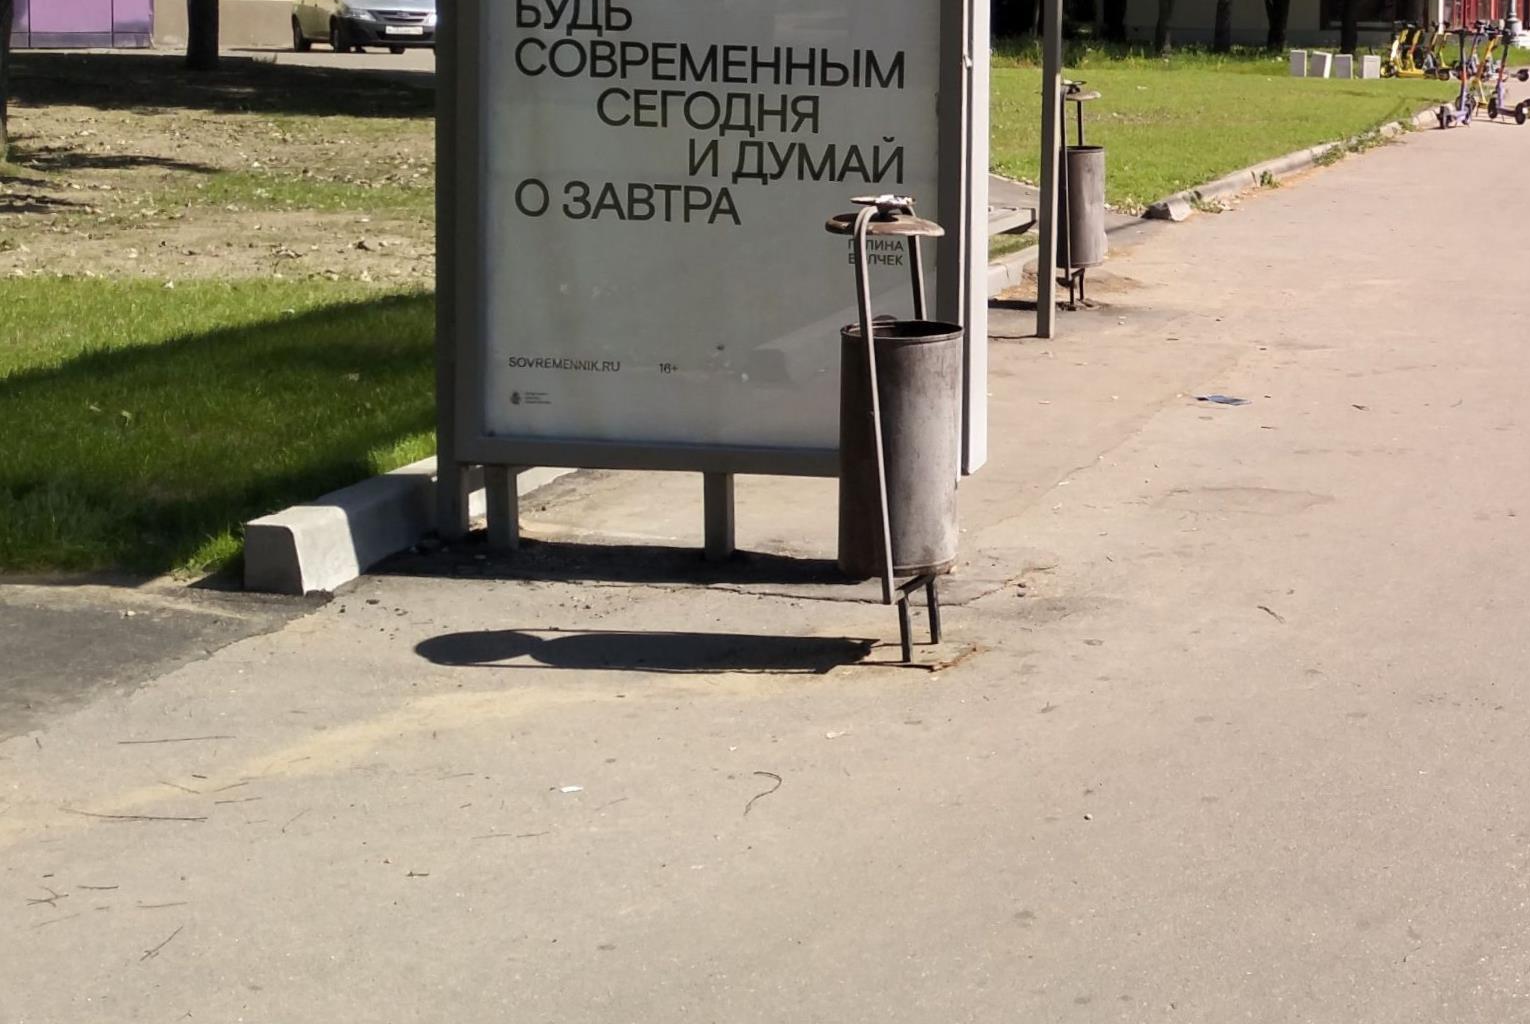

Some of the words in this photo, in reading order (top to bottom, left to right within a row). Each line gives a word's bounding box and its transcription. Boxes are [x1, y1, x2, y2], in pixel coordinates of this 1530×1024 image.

[515, 37, 905, 89] СОВРЕМЕННЫМ
[597, 87, 820, 137] СЕГОДНЯ
[688, 138, 719, 177] И
[732, 136, 904, 185] ДУМАЙ
[515, 178, 550, 218] О
[563, 180, 742, 226] ЗАВТРА
[848, 239, 904, 252] ГЛИНА
[848, 253, 904, 266] ВЛЧЕК
[508, 357, 621, 372] SOVREMENNIK.RU
[659, 362, 679, 374] 16+
